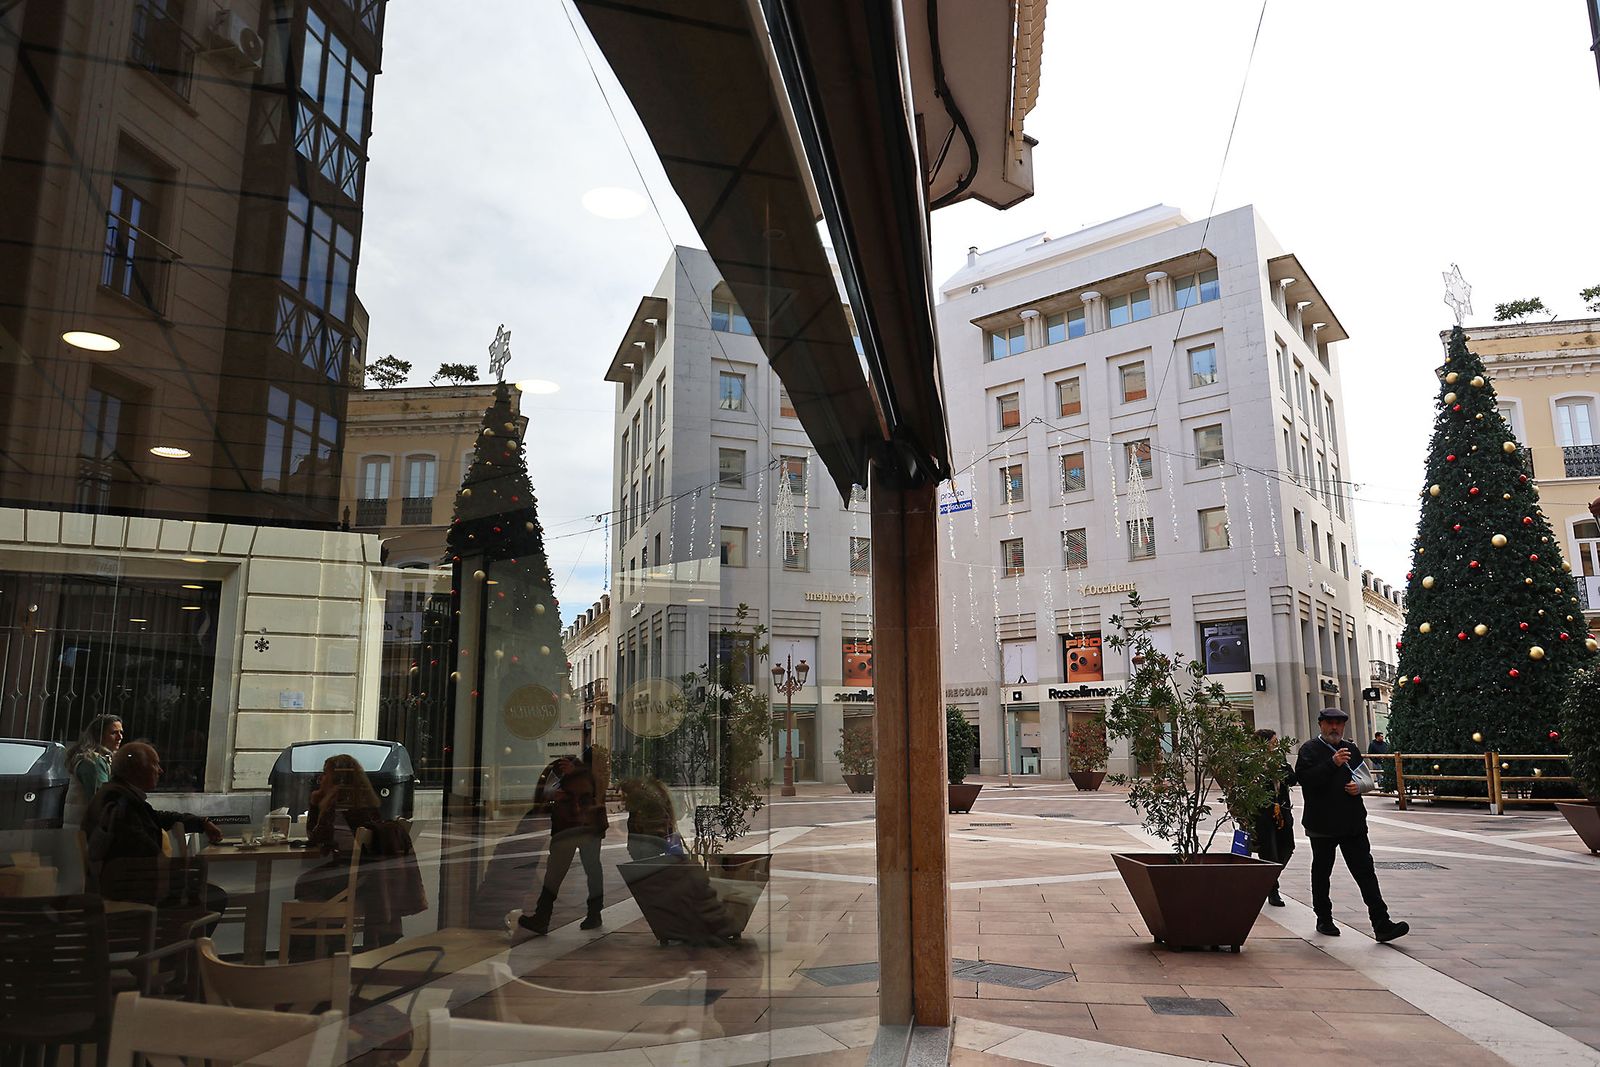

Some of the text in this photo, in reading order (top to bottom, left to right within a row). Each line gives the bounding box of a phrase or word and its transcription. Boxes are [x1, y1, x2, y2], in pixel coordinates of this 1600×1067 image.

[1090, 582, 1136, 595] Occident
[1204, 625, 1246, 636] PRO
[1066, 637, 1101, 648] PRO
